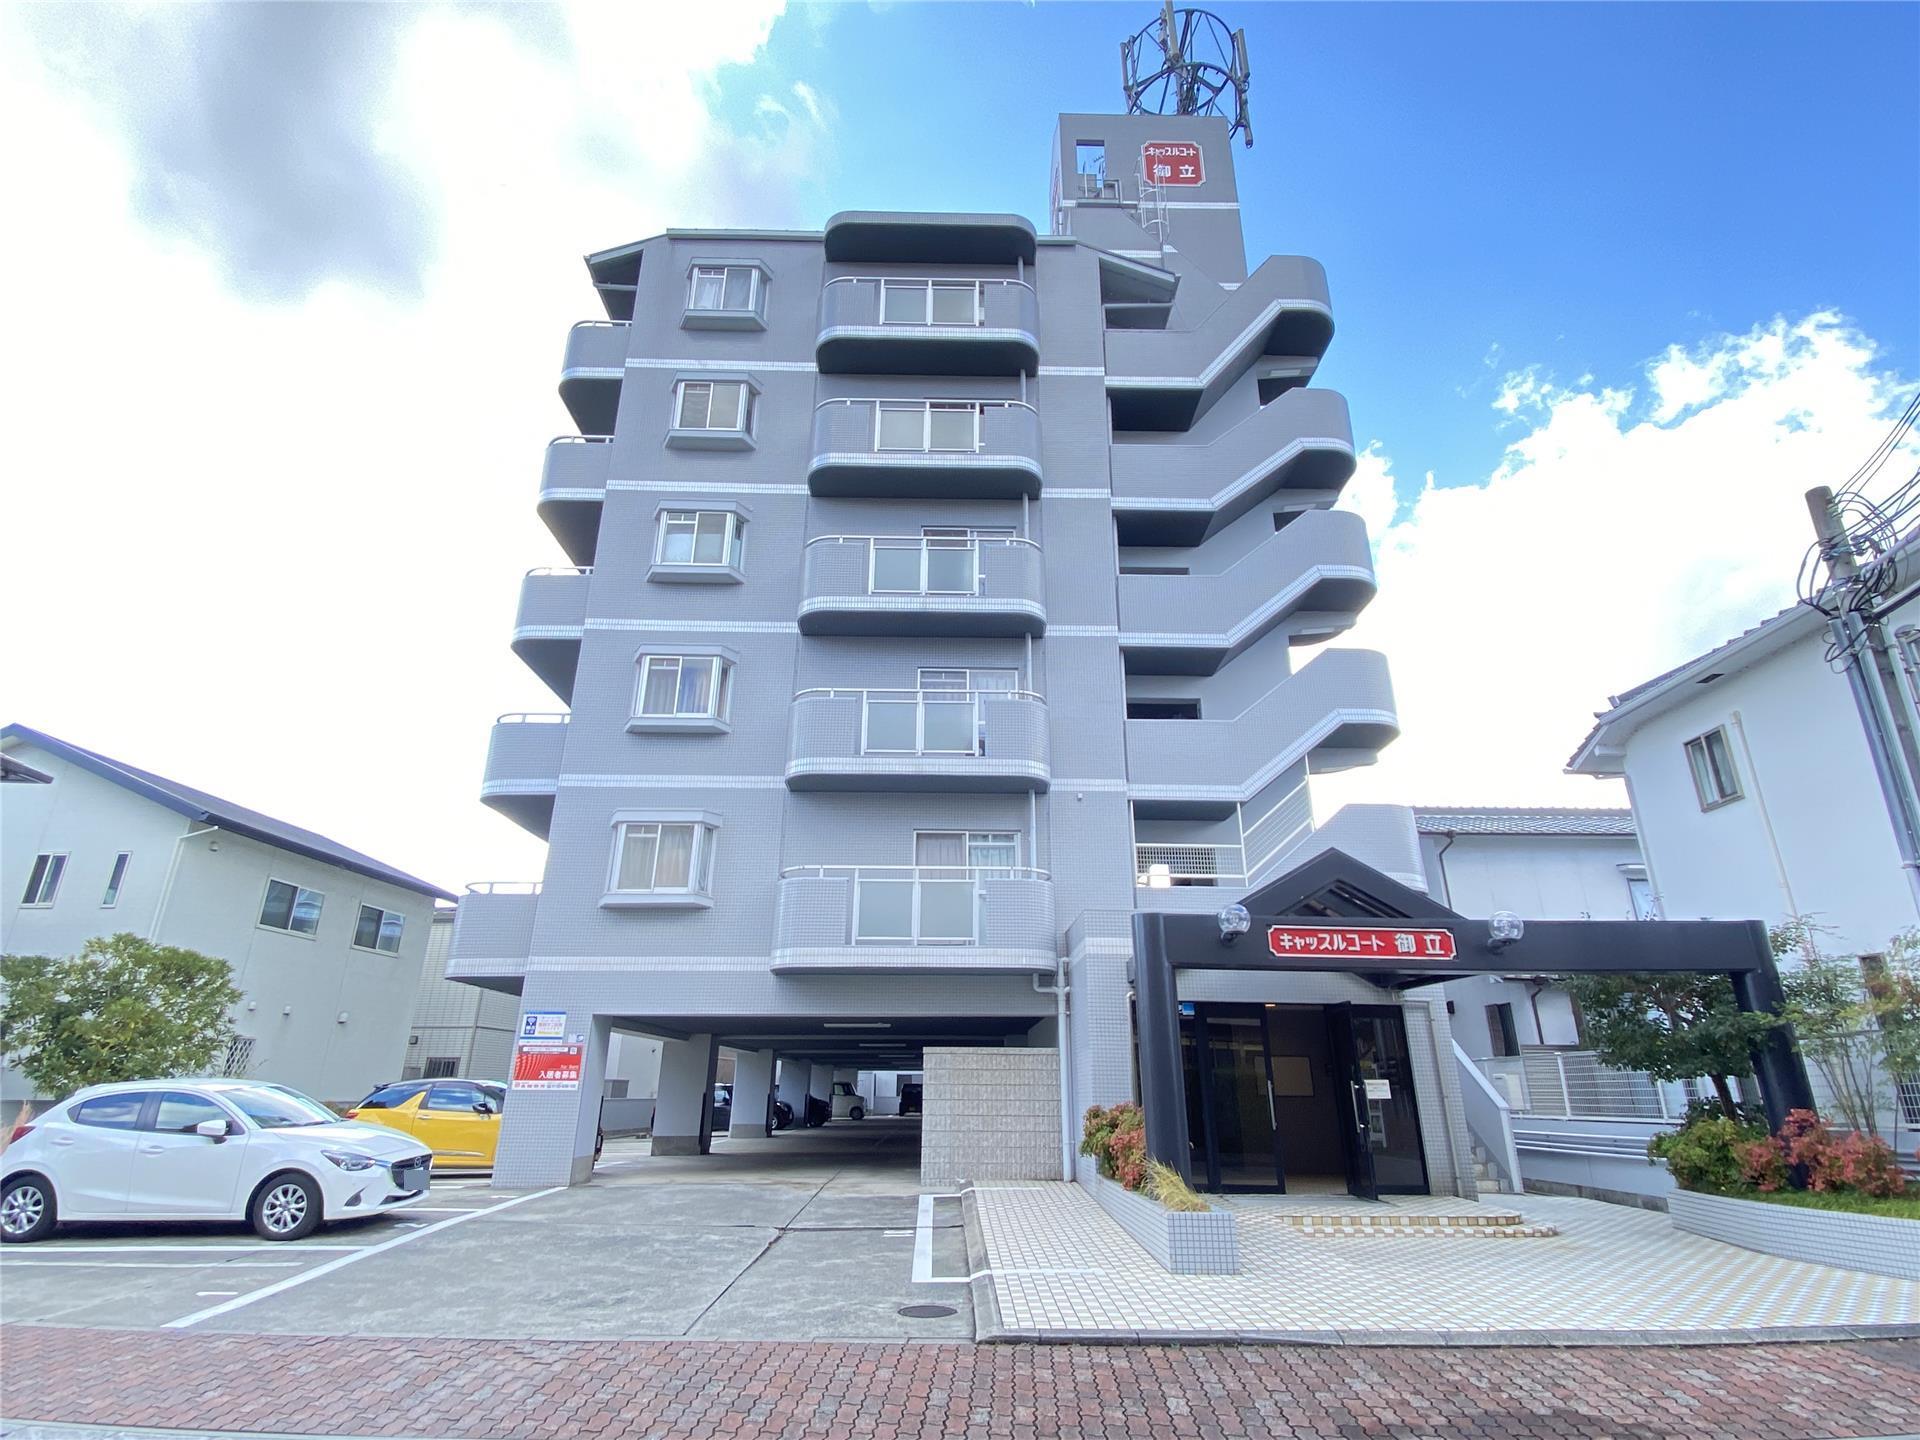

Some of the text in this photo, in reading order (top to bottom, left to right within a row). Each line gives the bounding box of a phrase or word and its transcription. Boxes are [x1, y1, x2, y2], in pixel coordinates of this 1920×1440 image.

[1279, 933, 1446, 954] キャッスルコート 御立
